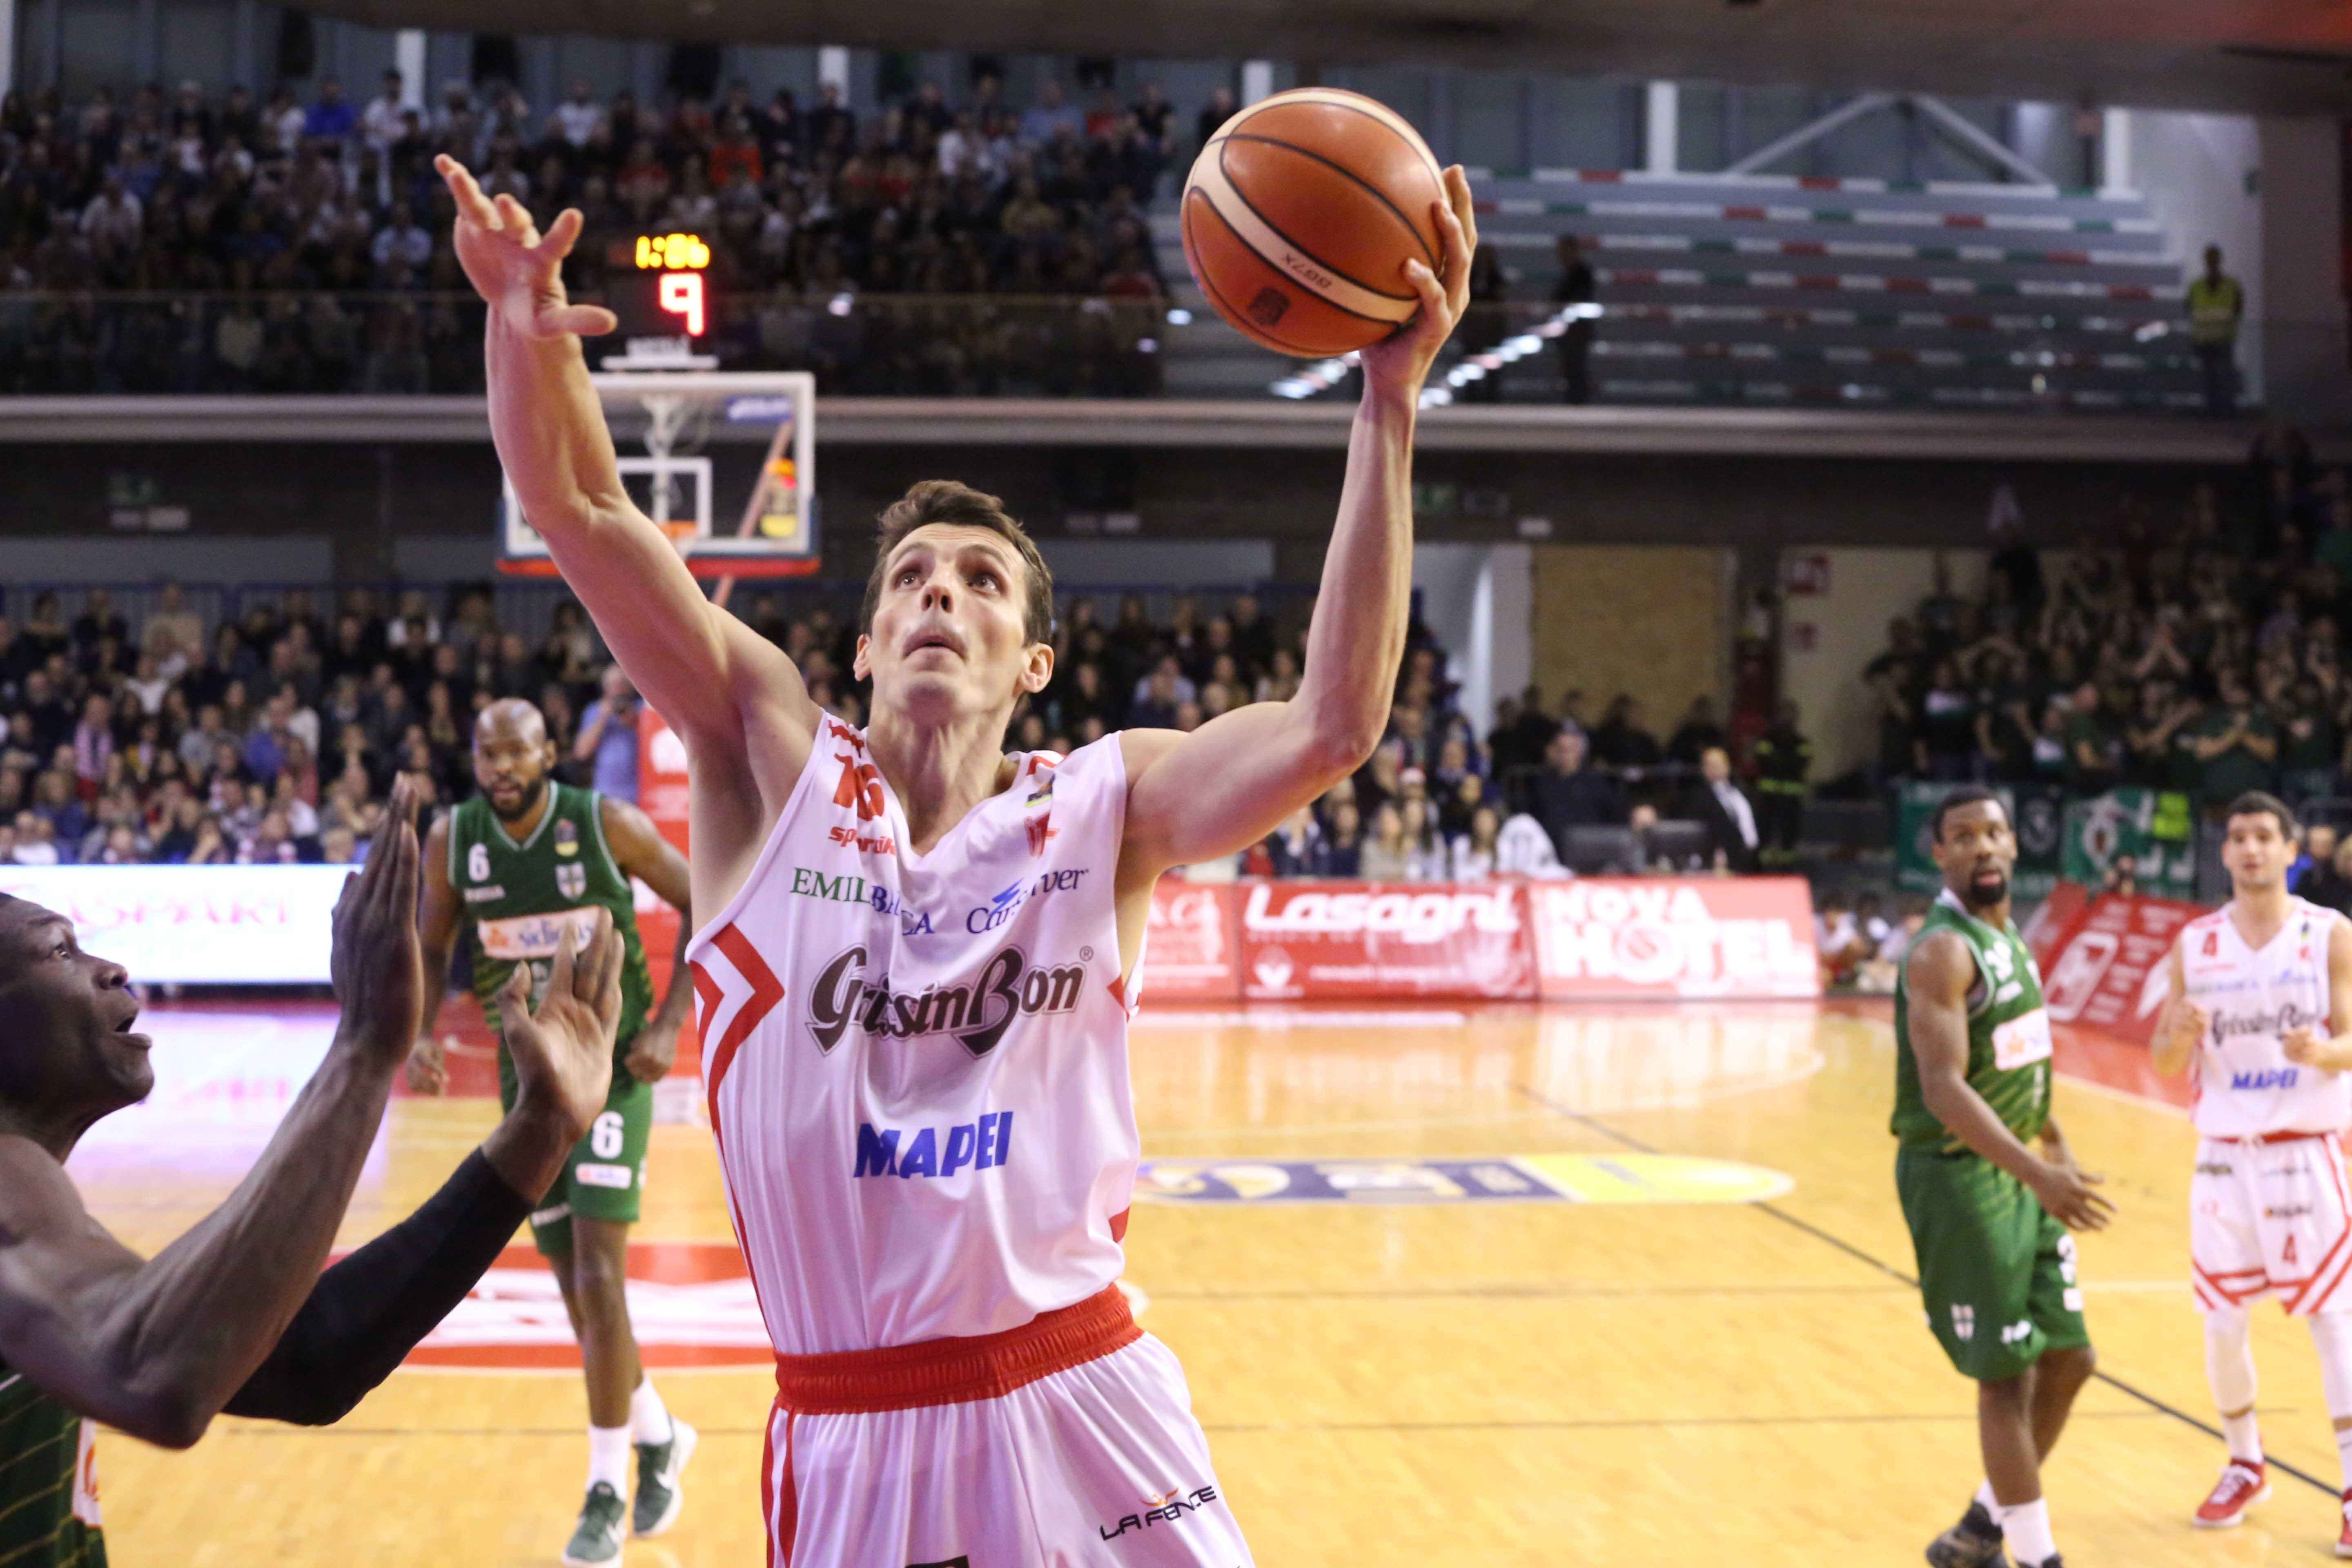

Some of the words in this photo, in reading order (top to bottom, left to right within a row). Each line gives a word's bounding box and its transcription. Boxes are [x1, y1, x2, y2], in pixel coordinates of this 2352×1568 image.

[659, 272, 705, 336] 9
[468, 843, 490, 882] 6
[1551, 918, 1815, 984] HOTEL
[2231, 1068, 2299, 1090] MAPEI
[591, 1111, 624, 1159] 6
[853, 1111, 1014, 1179] MAPEI
[1100, 1513, 1142, 1541] LA
